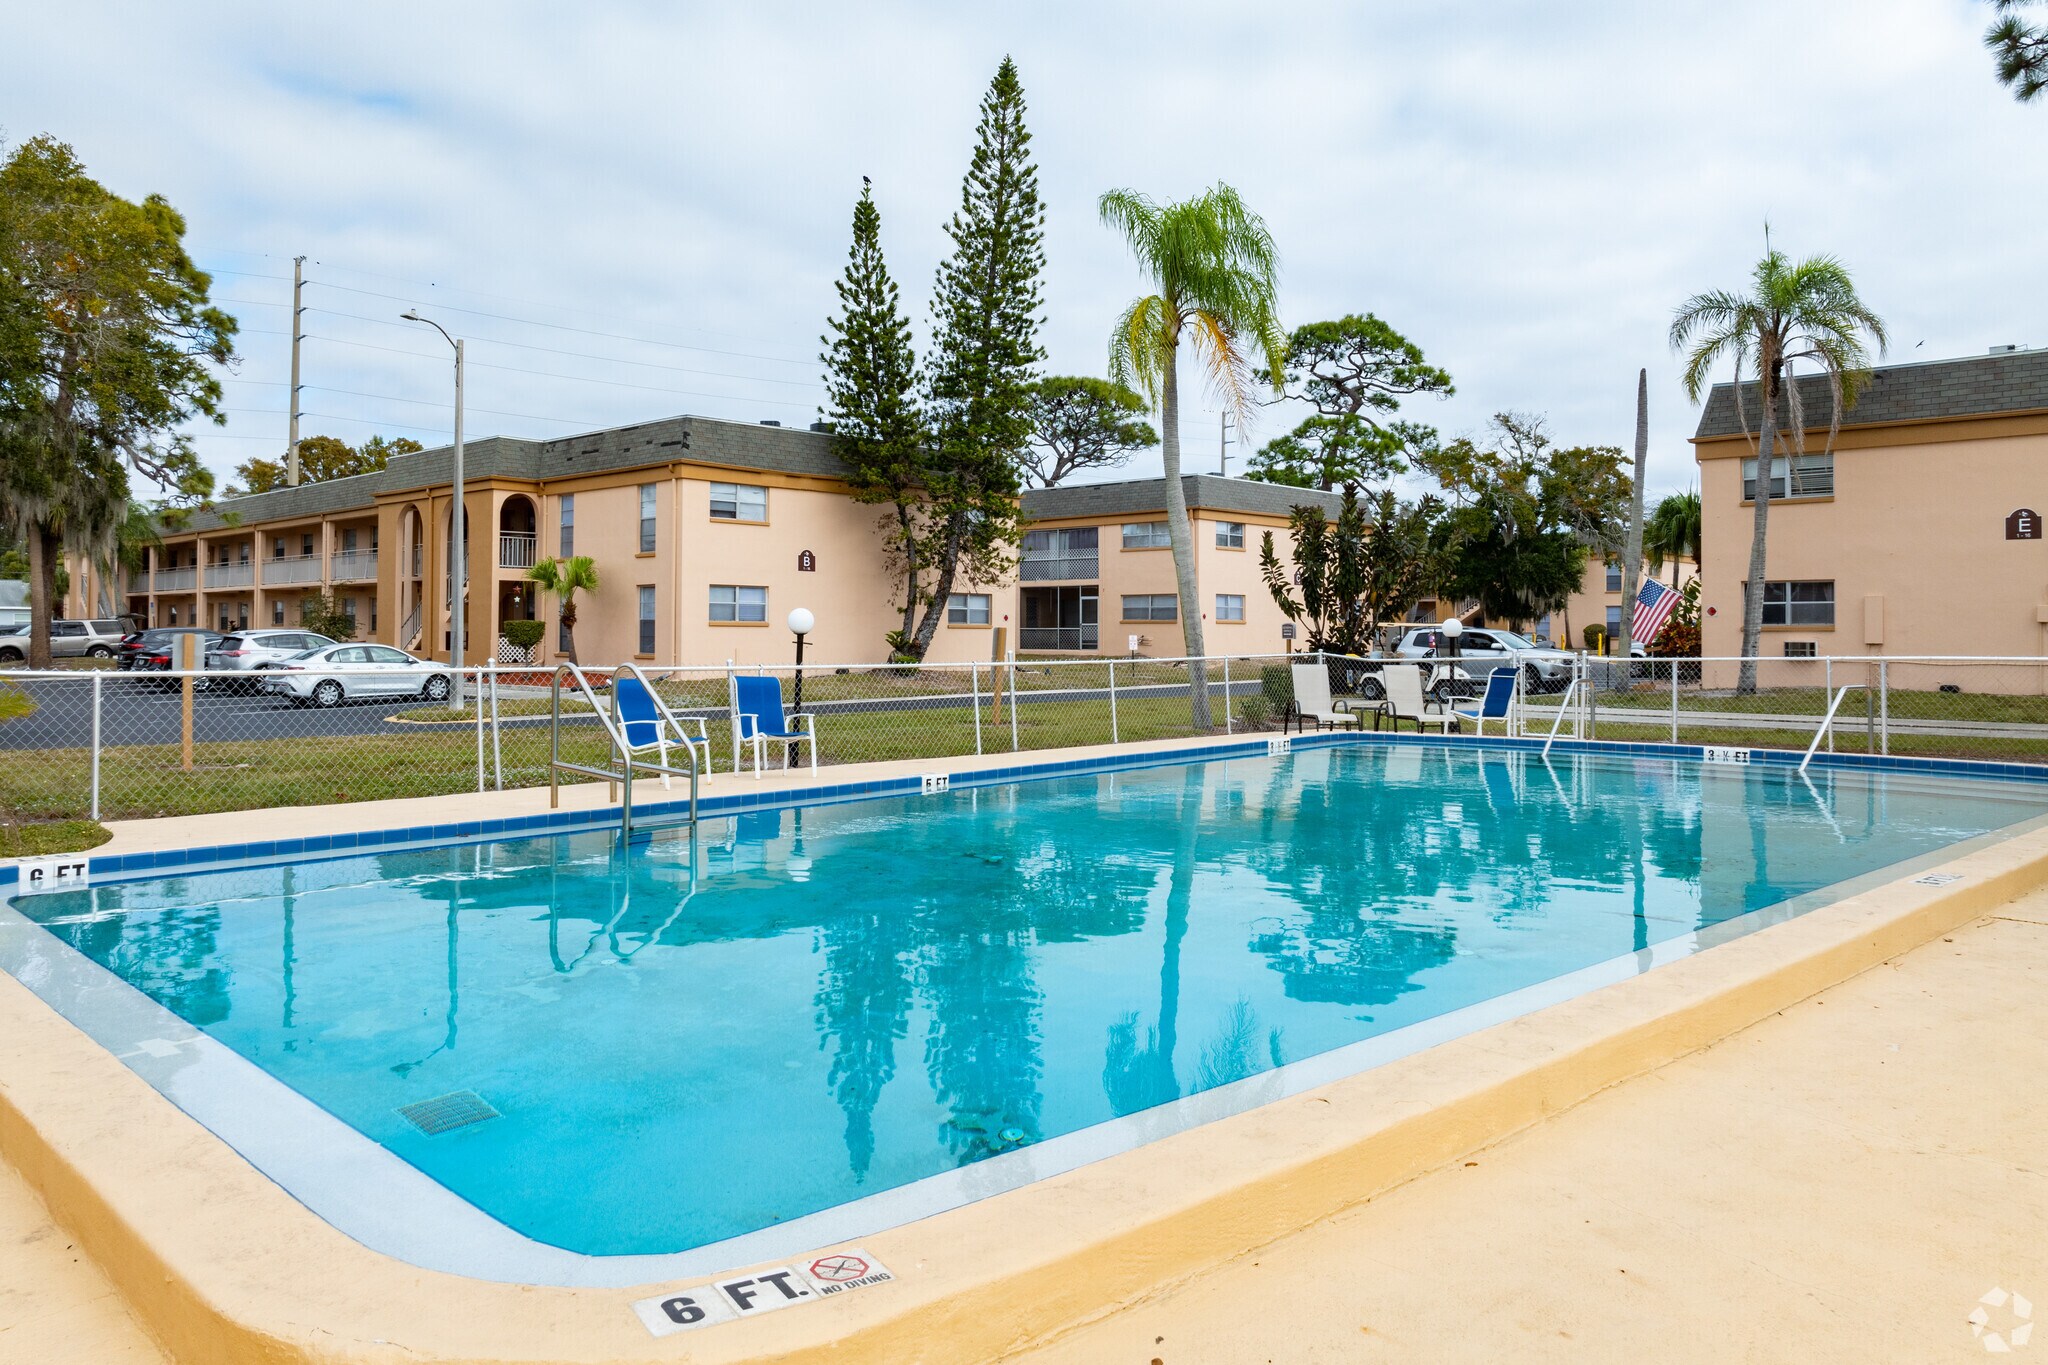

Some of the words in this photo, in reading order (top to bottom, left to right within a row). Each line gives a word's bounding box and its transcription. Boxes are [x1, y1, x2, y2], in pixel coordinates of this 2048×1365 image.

[2018, 518, 2031, 532] E
[803, 556, 811, 567] B
[936, 777, 947, 785] FT
[30, 868, 44, 881] 6
[57, 863, 85, 878] FT
[820, 1284, 842, 1295] NO
[844, 1272, 891, 1289] DIVING
[660, 1296, 706, 1324] 6
[723, 1270, 809, 1311] FT.
